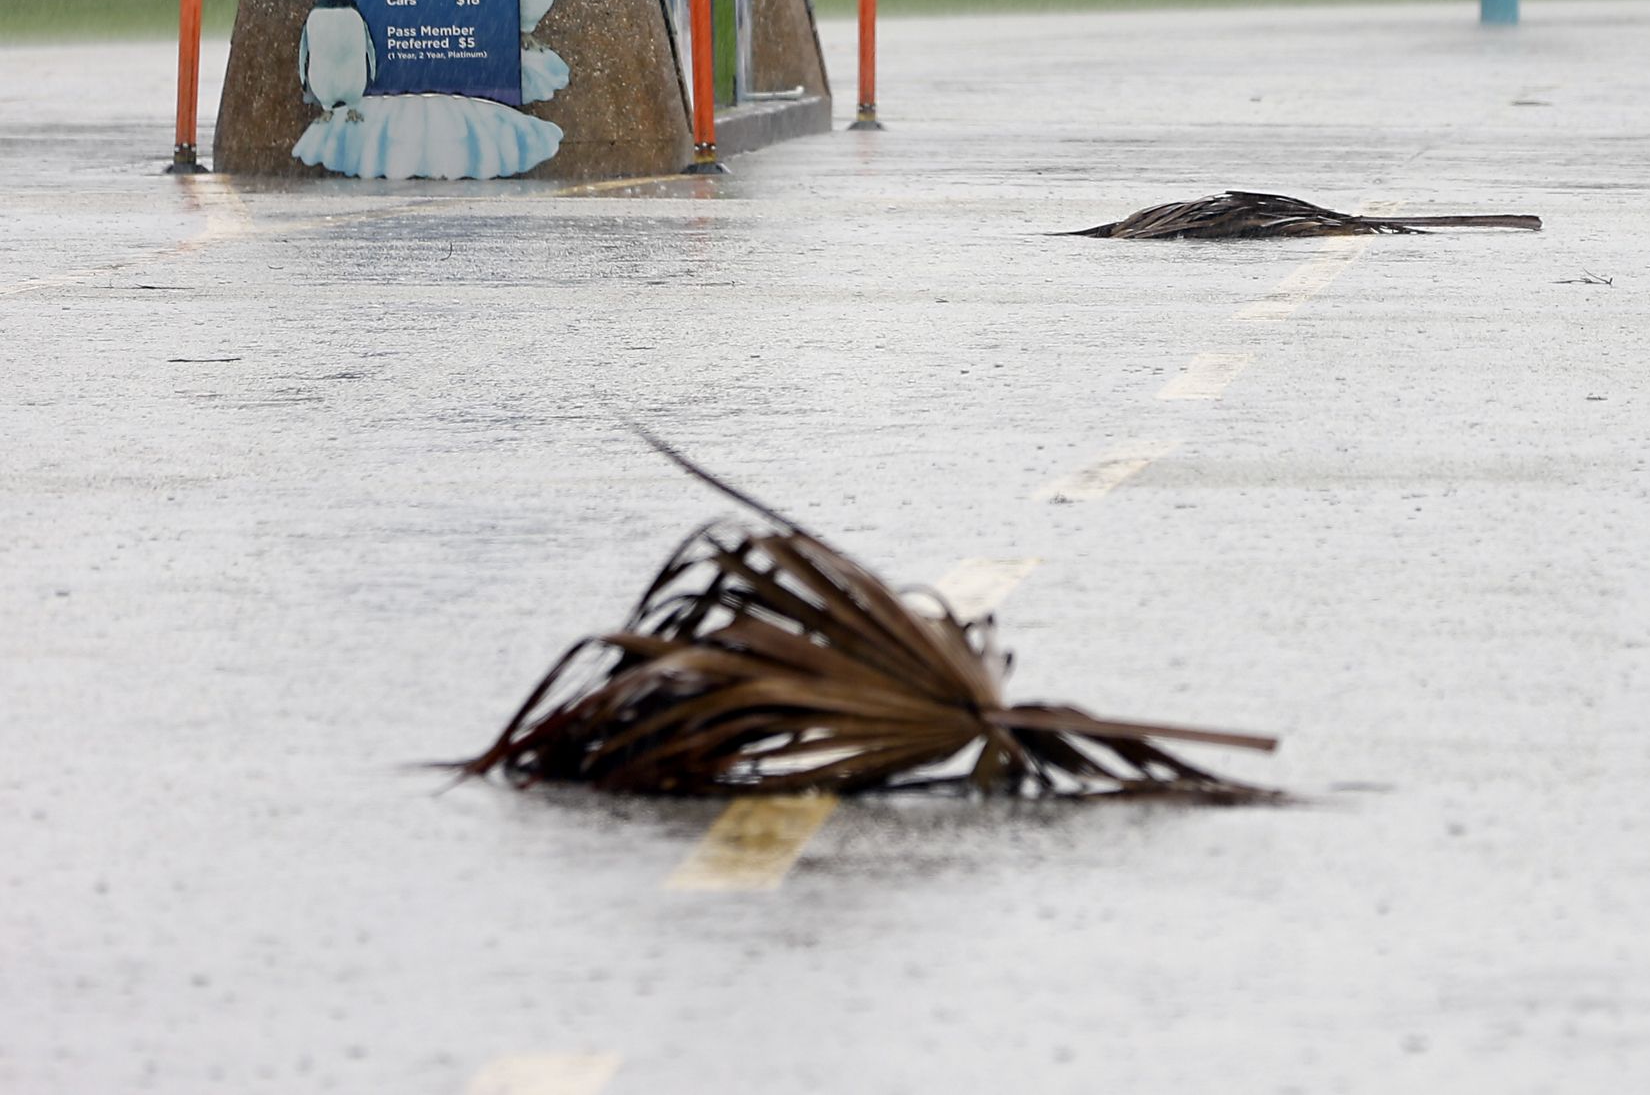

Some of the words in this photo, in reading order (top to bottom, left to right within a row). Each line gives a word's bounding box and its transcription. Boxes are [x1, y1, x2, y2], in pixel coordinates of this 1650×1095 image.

[387, 26, 417, 37] Pass
[420, 25, 475, 36] Member
[387, 38, 450, 49] Preferred
[458, 37, 476, 49] $5
[397, 52, 417, 60] Year,
[426, 51, 447, 60] Year,
[448, 50, 488, 59] Platinum)
